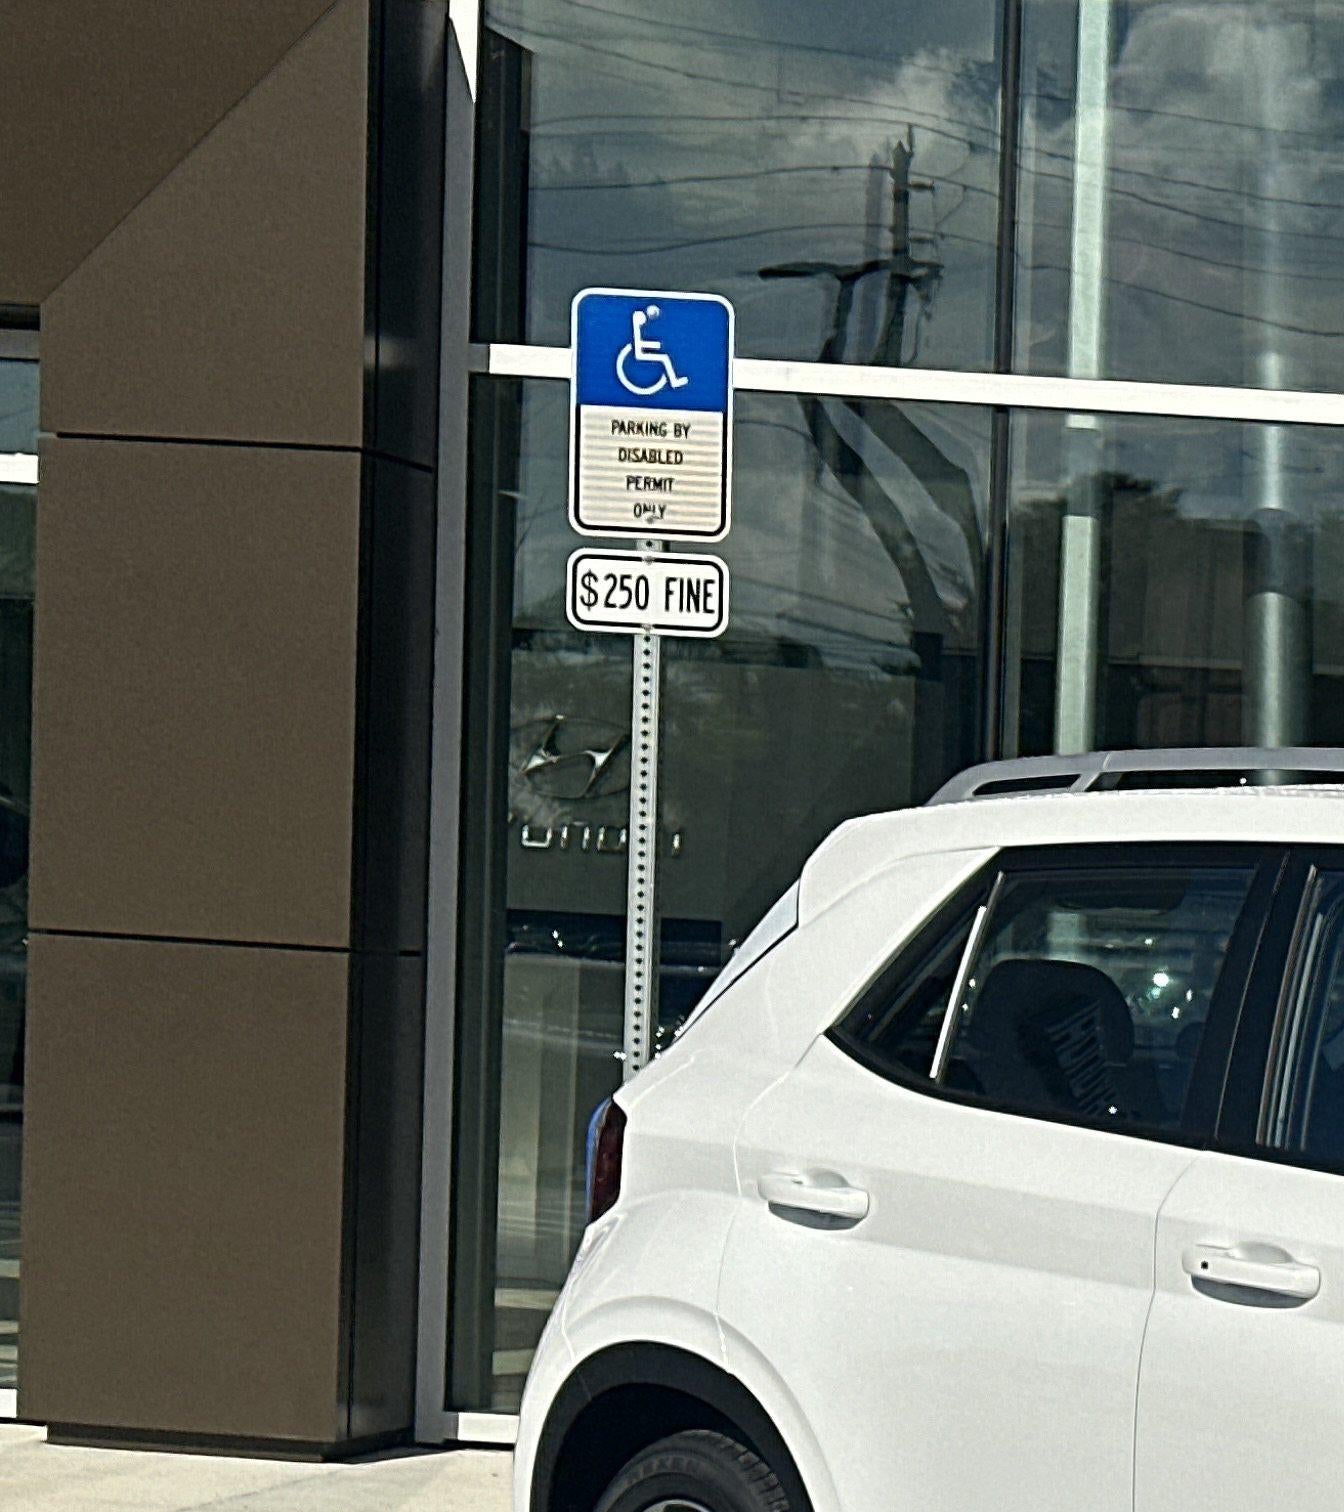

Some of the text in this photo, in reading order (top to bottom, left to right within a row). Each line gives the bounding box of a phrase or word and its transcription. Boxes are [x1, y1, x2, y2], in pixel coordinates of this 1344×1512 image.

[610, 419, 692, 439] PARKING BY
[617, 446, 684, 465] DISABLED
[625, 475, 676, 493] PERMIT
[632, 502, 667, 520] ONLY
[579, 568, 716, 614] $250 FINE
